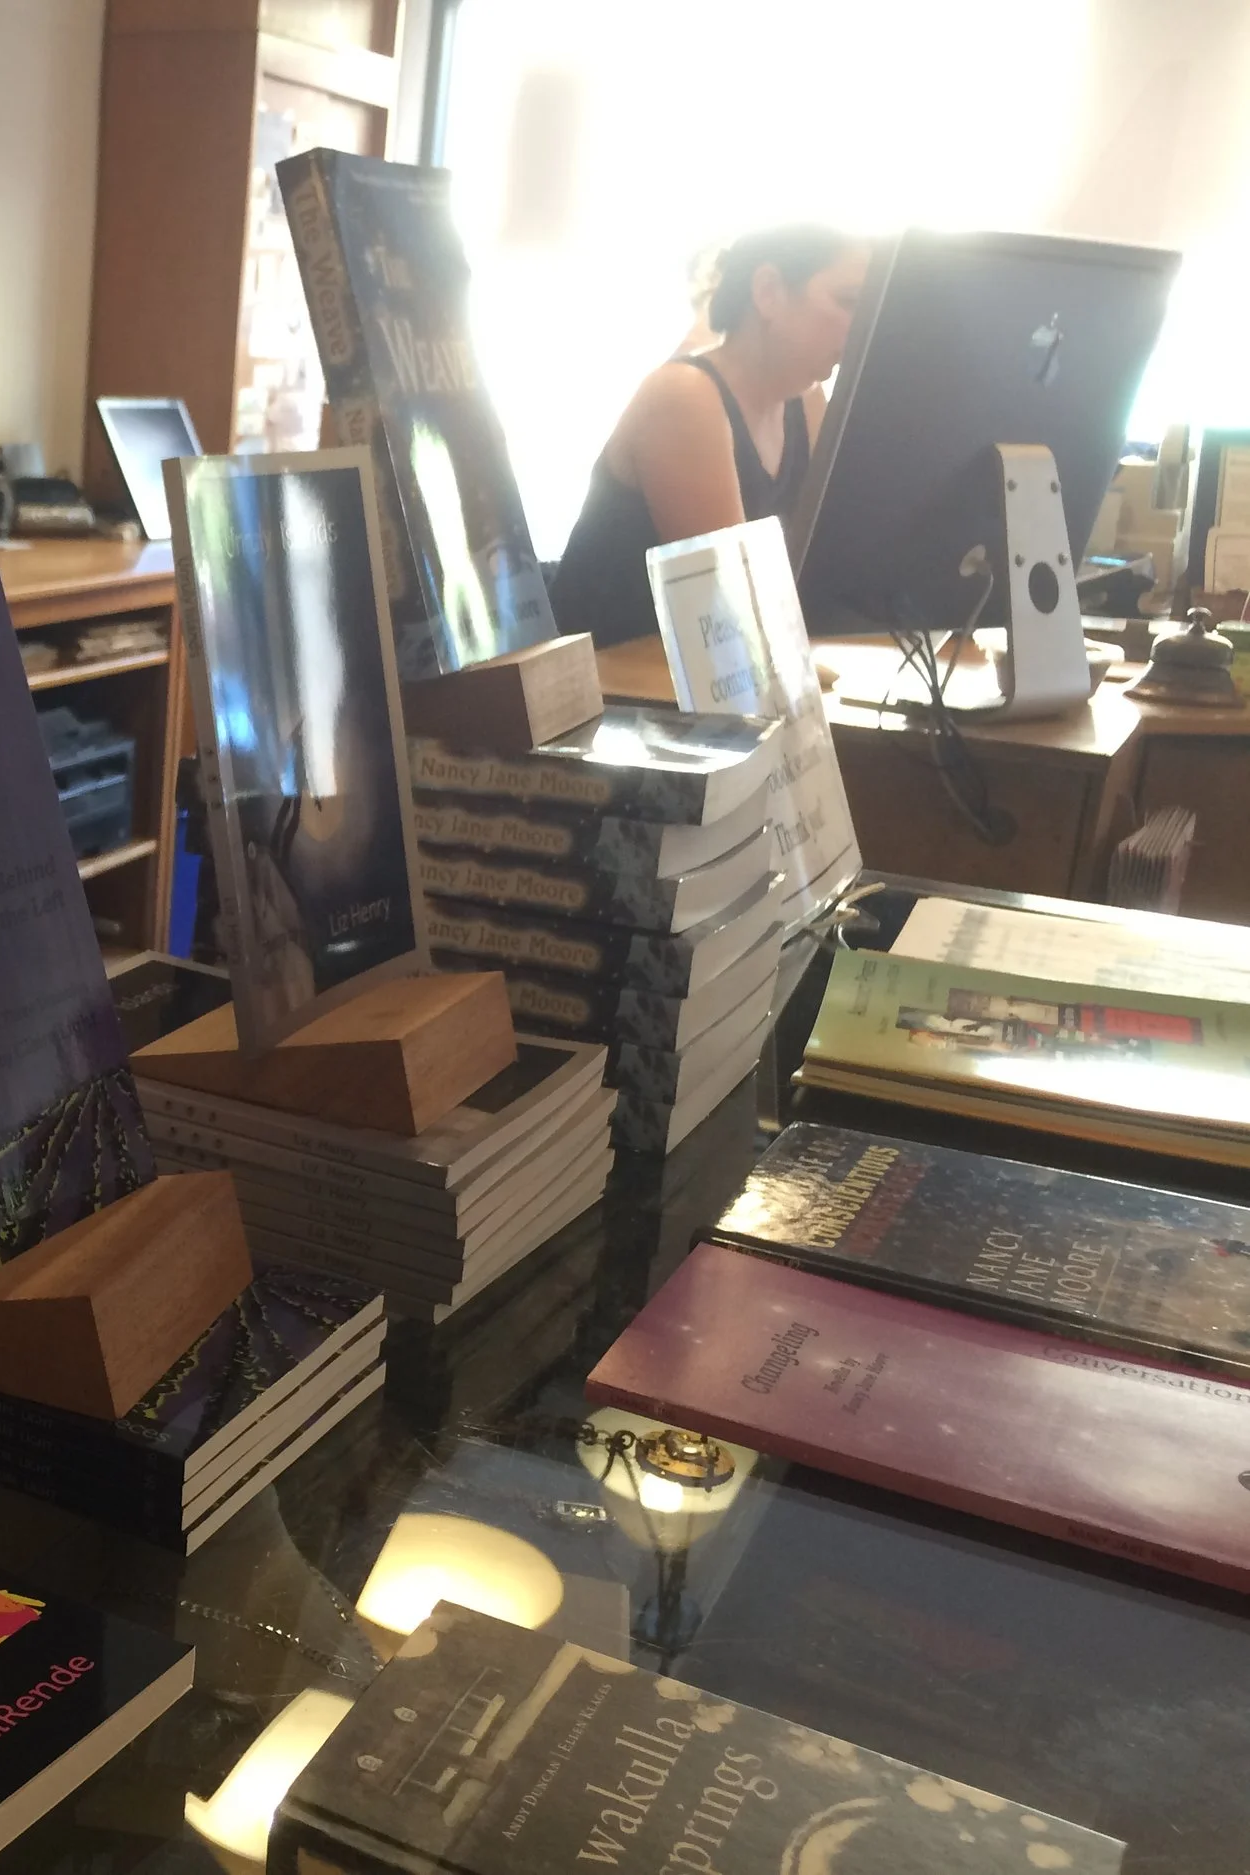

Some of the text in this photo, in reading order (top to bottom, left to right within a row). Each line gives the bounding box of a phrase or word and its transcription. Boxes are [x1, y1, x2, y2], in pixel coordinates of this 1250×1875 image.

[309, 254, 346, 357] Weave
[420, 757, 607, 798] Nancy Jane Moore
[451, 812, 494, 838] Jane
[502, 822, 565, 848] Moore
[350, 897, 390, 927] Henry
[466, 864, 509, 892] Jane
[515, 873, 581, 902] Moore
[478, 922, 521, 951] Jane
[528, 934, 594, 965] Moore
[518, 988, 584, 1019] Moore
[808, 1144, 901, 1249] CONSCIENTIOUS
[965, 1226, 1023, 1290] NANCY
[1006, 1251, 1056, 1301] JANE
[1050, 1240, 1106, 1308] MOORE
[741, 1321, 820, 1395] Changeling
[1042, 1345, 1250, 1404] Conversation
[502, 1682, 613, 1841] ANDY DUNCAN ELLEN KLAGES
[658, 1745, 779, 1875] prings
